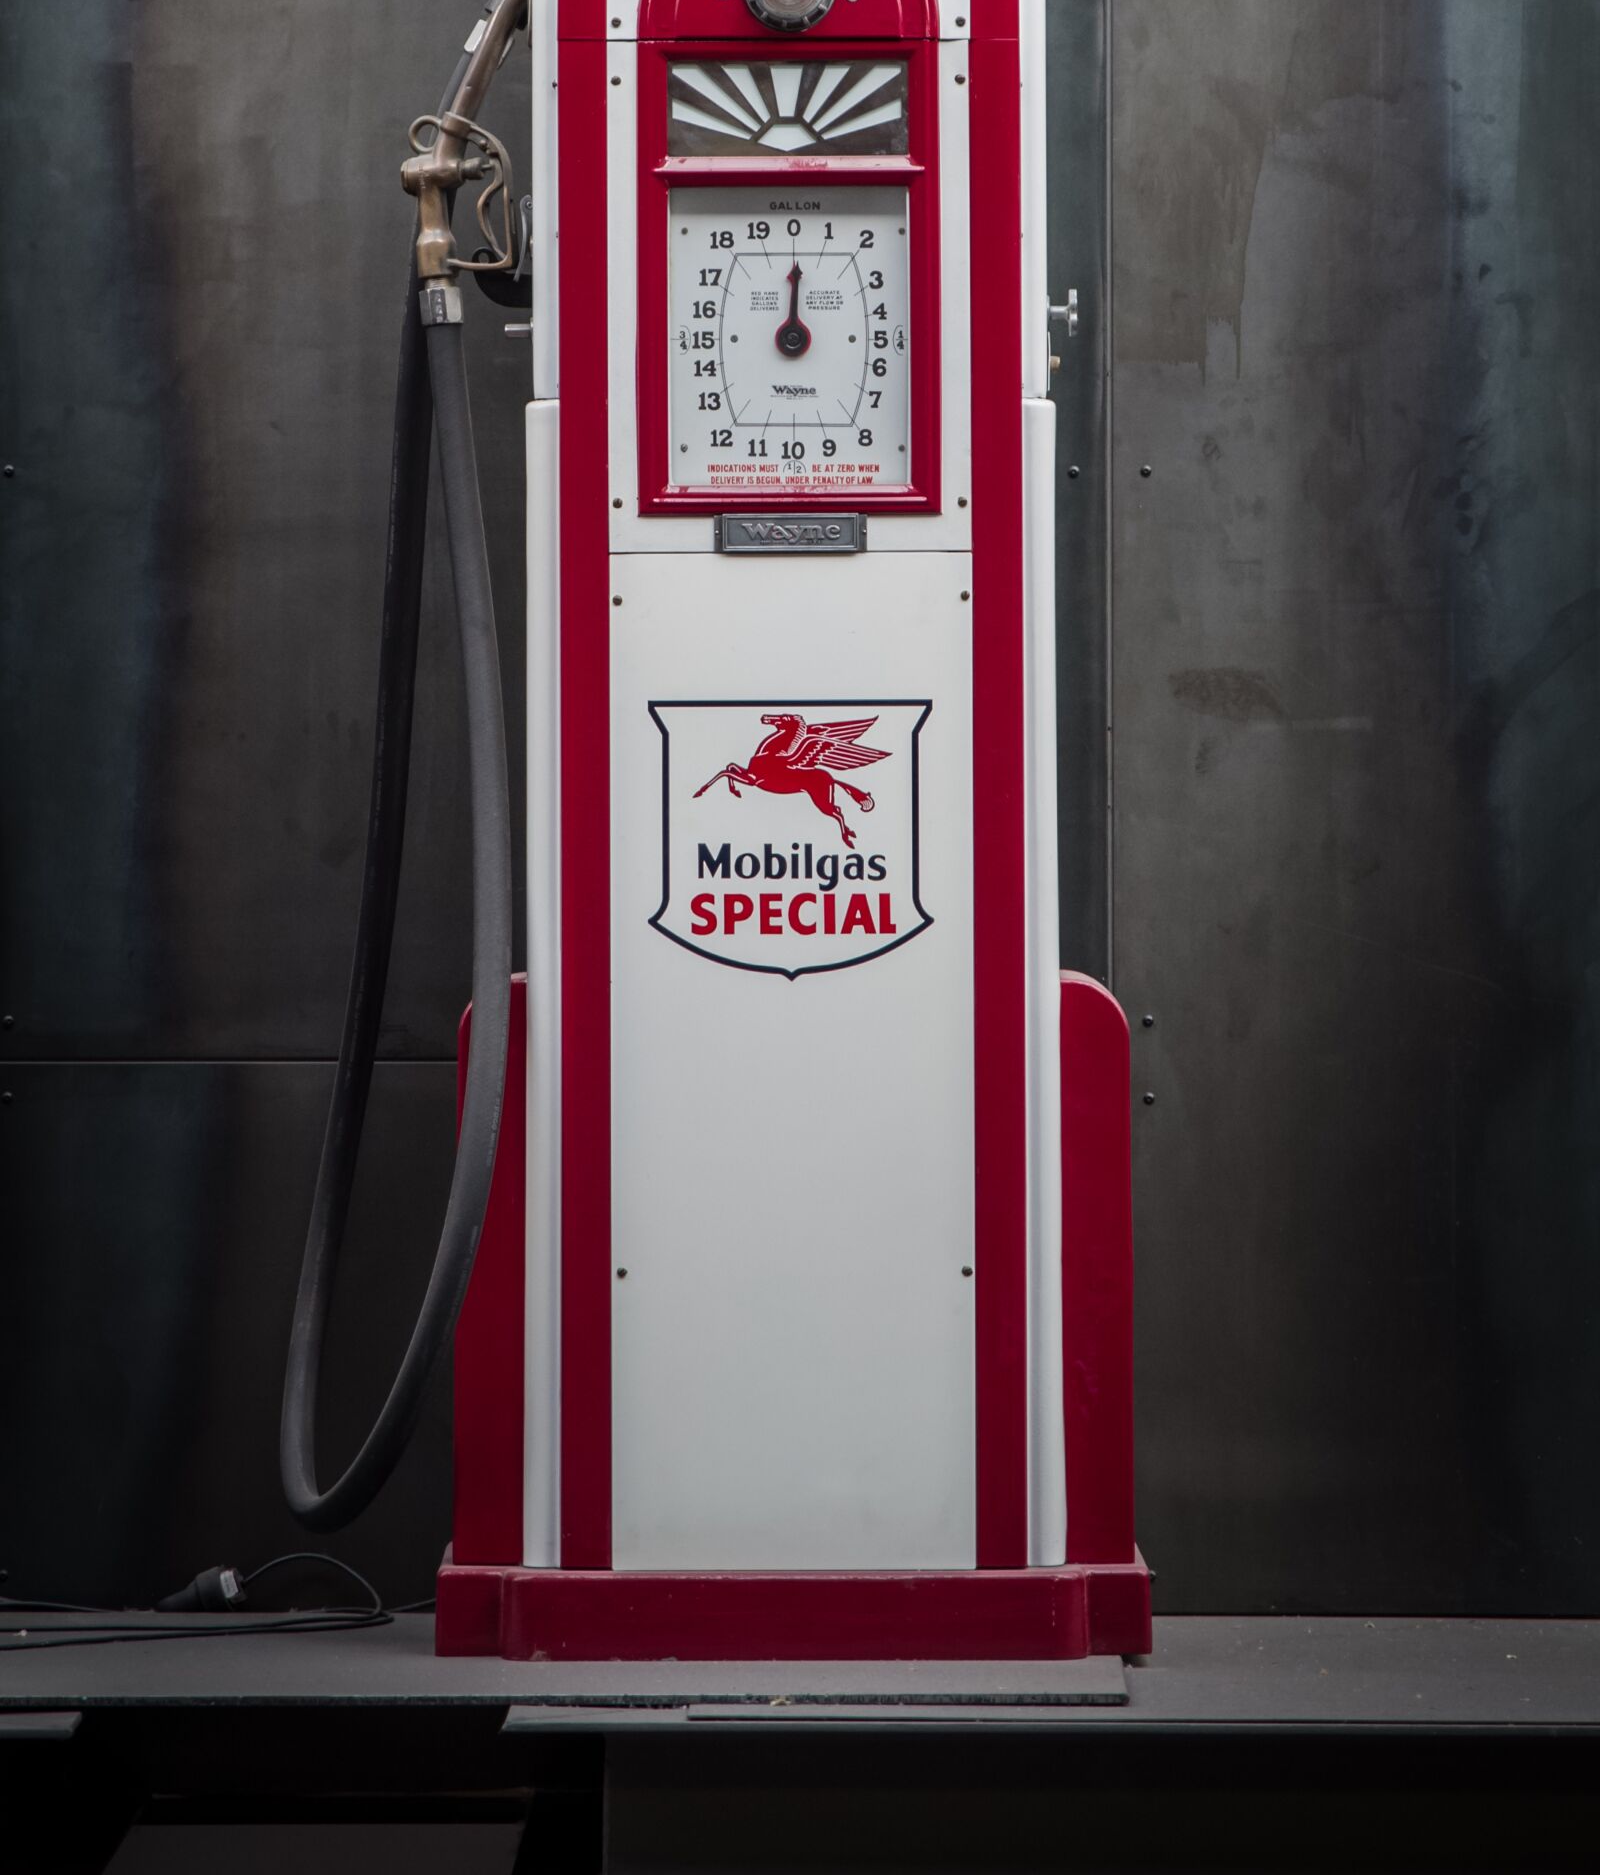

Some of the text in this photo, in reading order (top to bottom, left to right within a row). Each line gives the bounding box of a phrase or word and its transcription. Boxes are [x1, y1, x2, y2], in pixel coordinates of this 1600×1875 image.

[769, 201, 821, 211] GALLON
[747, 221, 770, 240] 19
[787, 219, 801, 237] 0
[824, 222, 834, 240] 1
[709, 231, 735, 250] 18
[859, 229, 874, 249] 2
[699, 268, 722, 287] 17
[868, 270, 884, 290] 3
[692, 300, 716, 319] 16
[872, 302, 888, 320] 4
[691, 331, 716, 350] 15
[873, 330, 889, 349] 5
[693, 360, 717, 377] 14
[872, 357, 887, 377] 6
[771, 384, 817, 397] Wayne
[868, 390, 882, 409] 7
[698, 392, 721, 411] 13
[710, 429, 734, 447] 12
[857, 428, 874, 447] 8
[747, 439, 768, 457] 11
[781, 441, 805, 459] 10
[822, 439, 837, 457] 9
[707, 464, 880, 473] INDICATIONS MUST BE AT ZERO WHEN
[711, 475, 745, 485] DELIVERY
[747, 475, 754, 485] IS
[785, 475, 810, 485] UNDER
[813, 475, 843, 485] PENALTY
[845, 475, 854, 485] OF
[741, 522, 841, 545] Wayne
[697, 842, 887, 892] Mobilgas
[690, 892, 897, 936] SPECIAL
